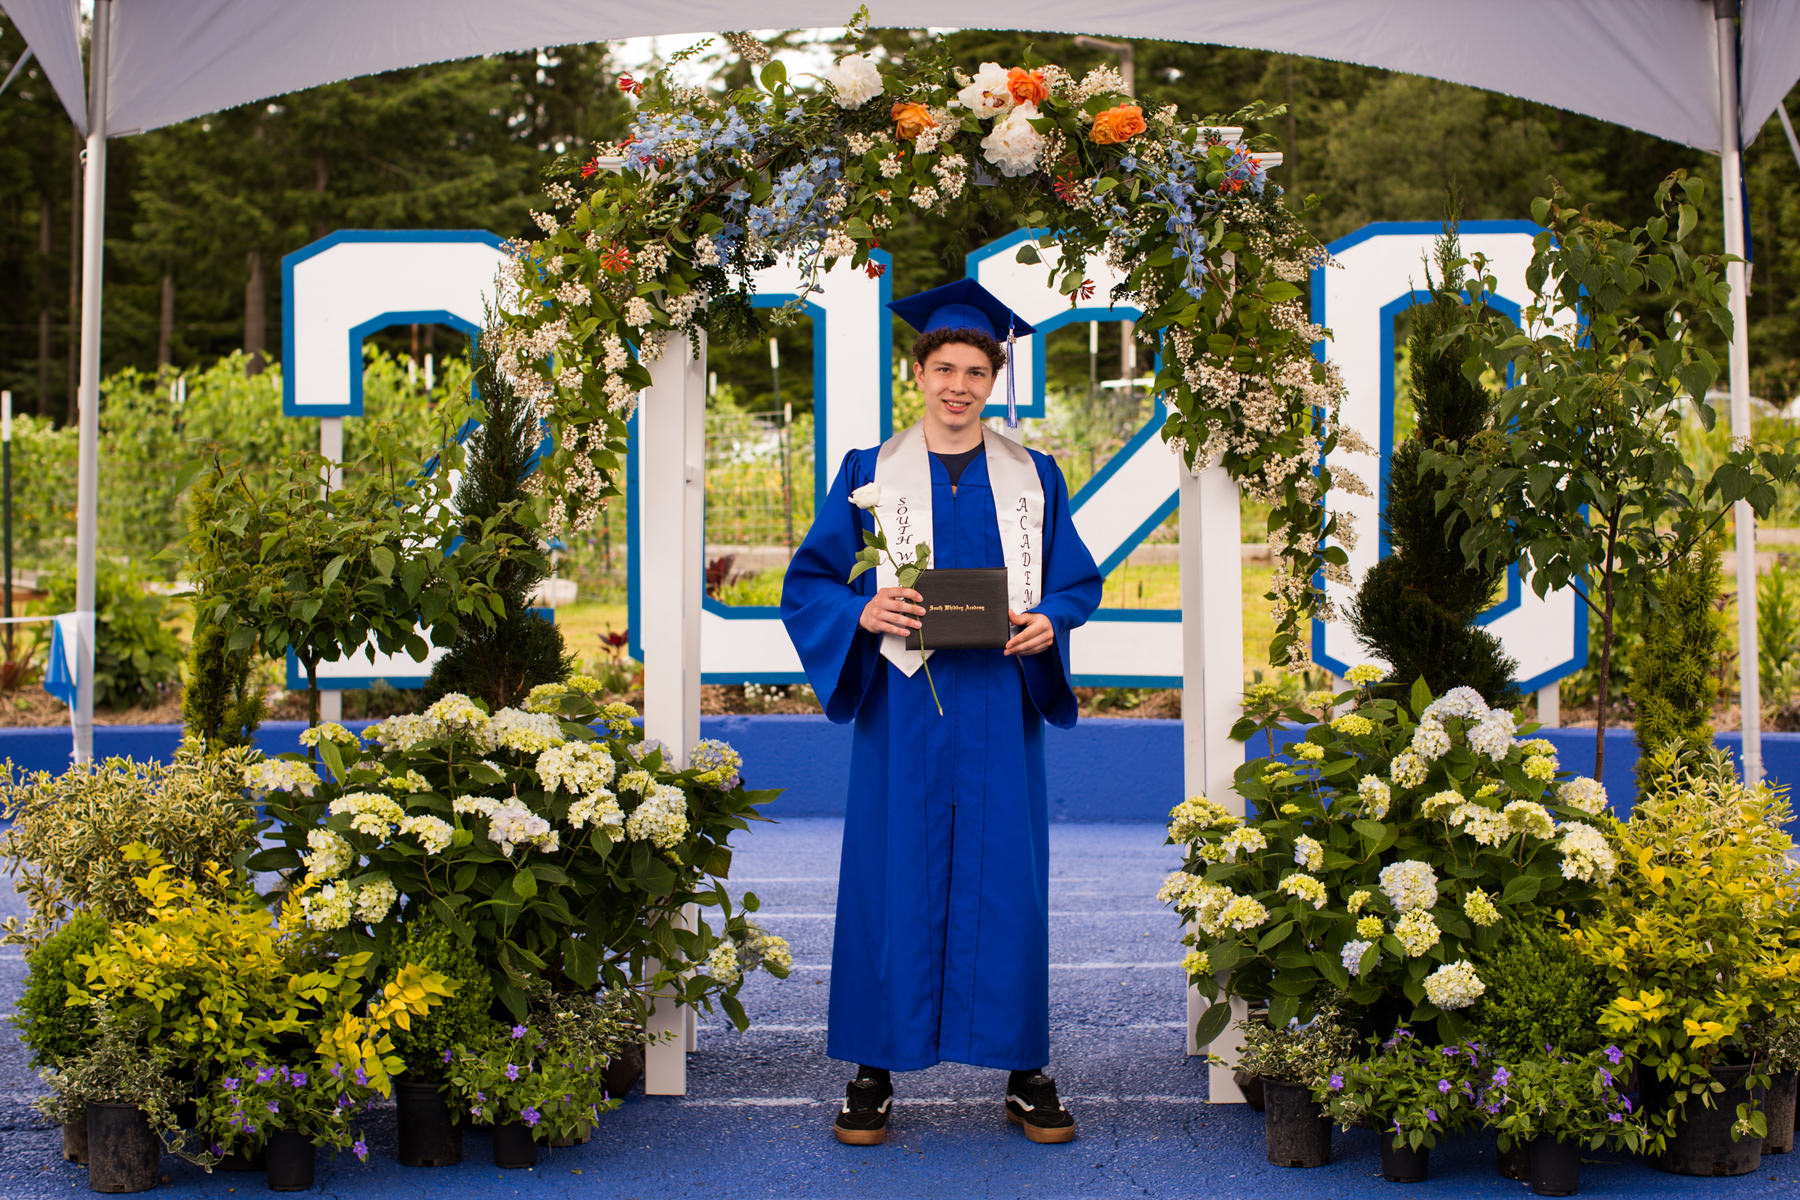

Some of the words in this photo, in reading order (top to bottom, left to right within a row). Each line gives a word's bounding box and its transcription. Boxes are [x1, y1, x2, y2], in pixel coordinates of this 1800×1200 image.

[895, 497, 914, 545] SOUTH
[1016, 497, 1033, 610] ACADEM
[965, 604, 985, 612] Academy
